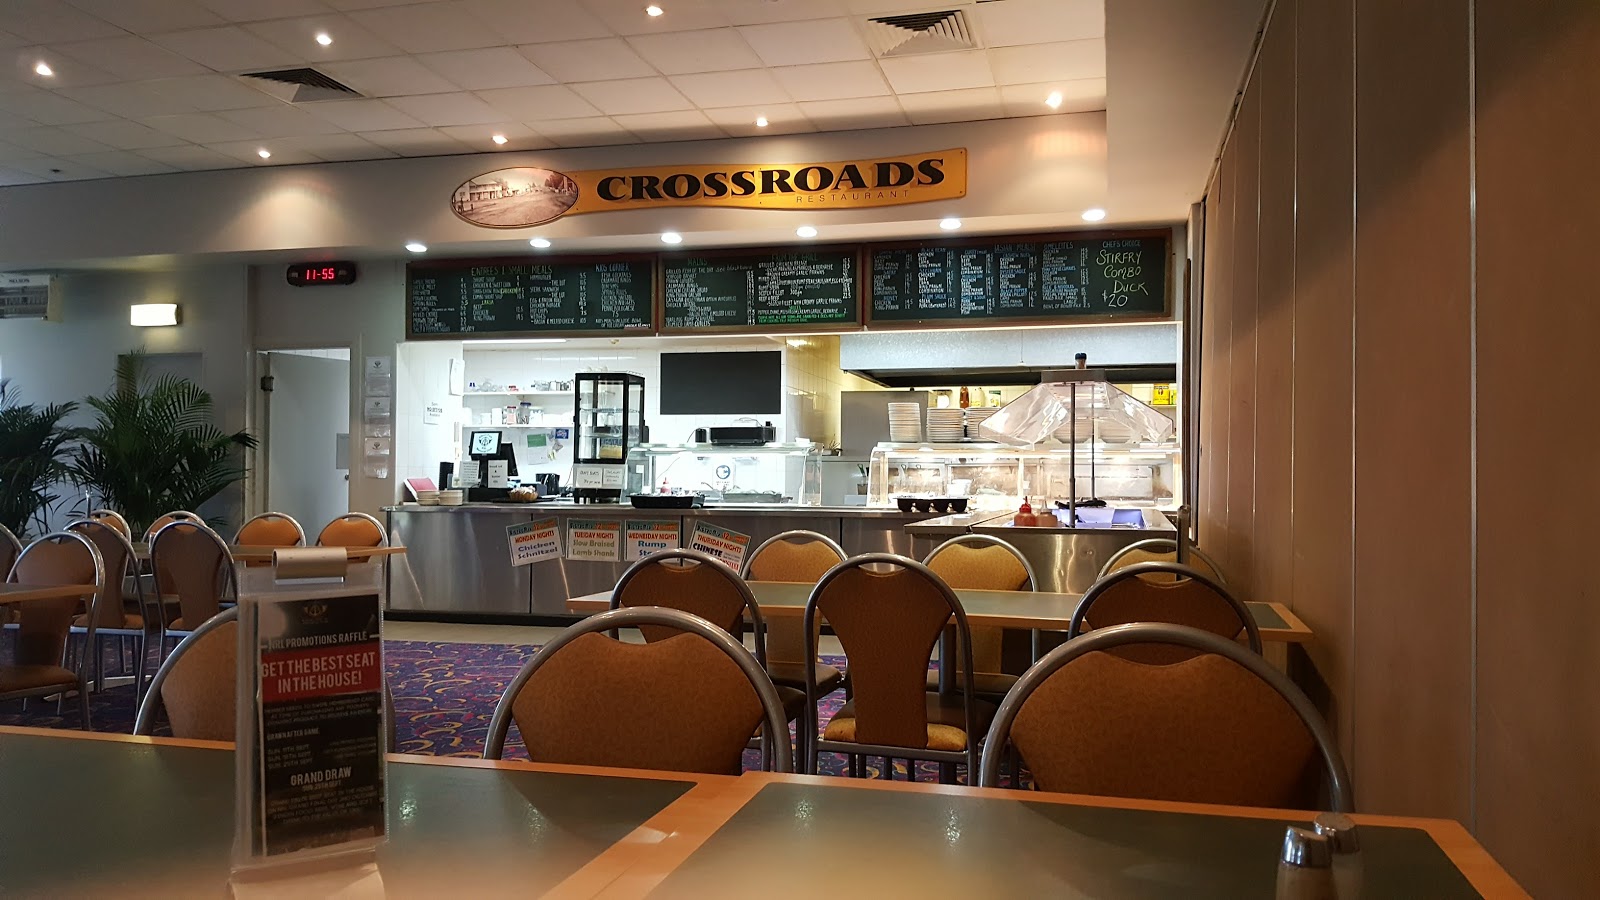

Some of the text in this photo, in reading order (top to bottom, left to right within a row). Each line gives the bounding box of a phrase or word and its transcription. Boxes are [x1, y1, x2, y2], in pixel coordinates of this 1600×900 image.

[597, 158, 944, 200] CROSSROADS
[796, 190, 909, 202] RESTAURANT
[1122, 240, 1141, 248] CHOICE
[1096, 249, 1142, 265] STIRFRY
[1104, 265, 1142, 280] COMBO
[515, 530, 554, 544] MONDAY NIGHTS
[697, 534, 742, 554] THURSDAY NIGHTS
[518, 541, 555, 552] Chicken
[518, 547, 558, 560] Schnitzel
[692, 542, 723, 558] CHINESE
[286, 634, 337, 648] PROMOTIONS
[338, 631, 368, 642] RAFFLE
[262, 652, 375, 678] GET THE BEST SEAT
[278, 670, 362, 694] IN THE HOUSE!
[290, 766, 352, 786] GRAND DRAW
